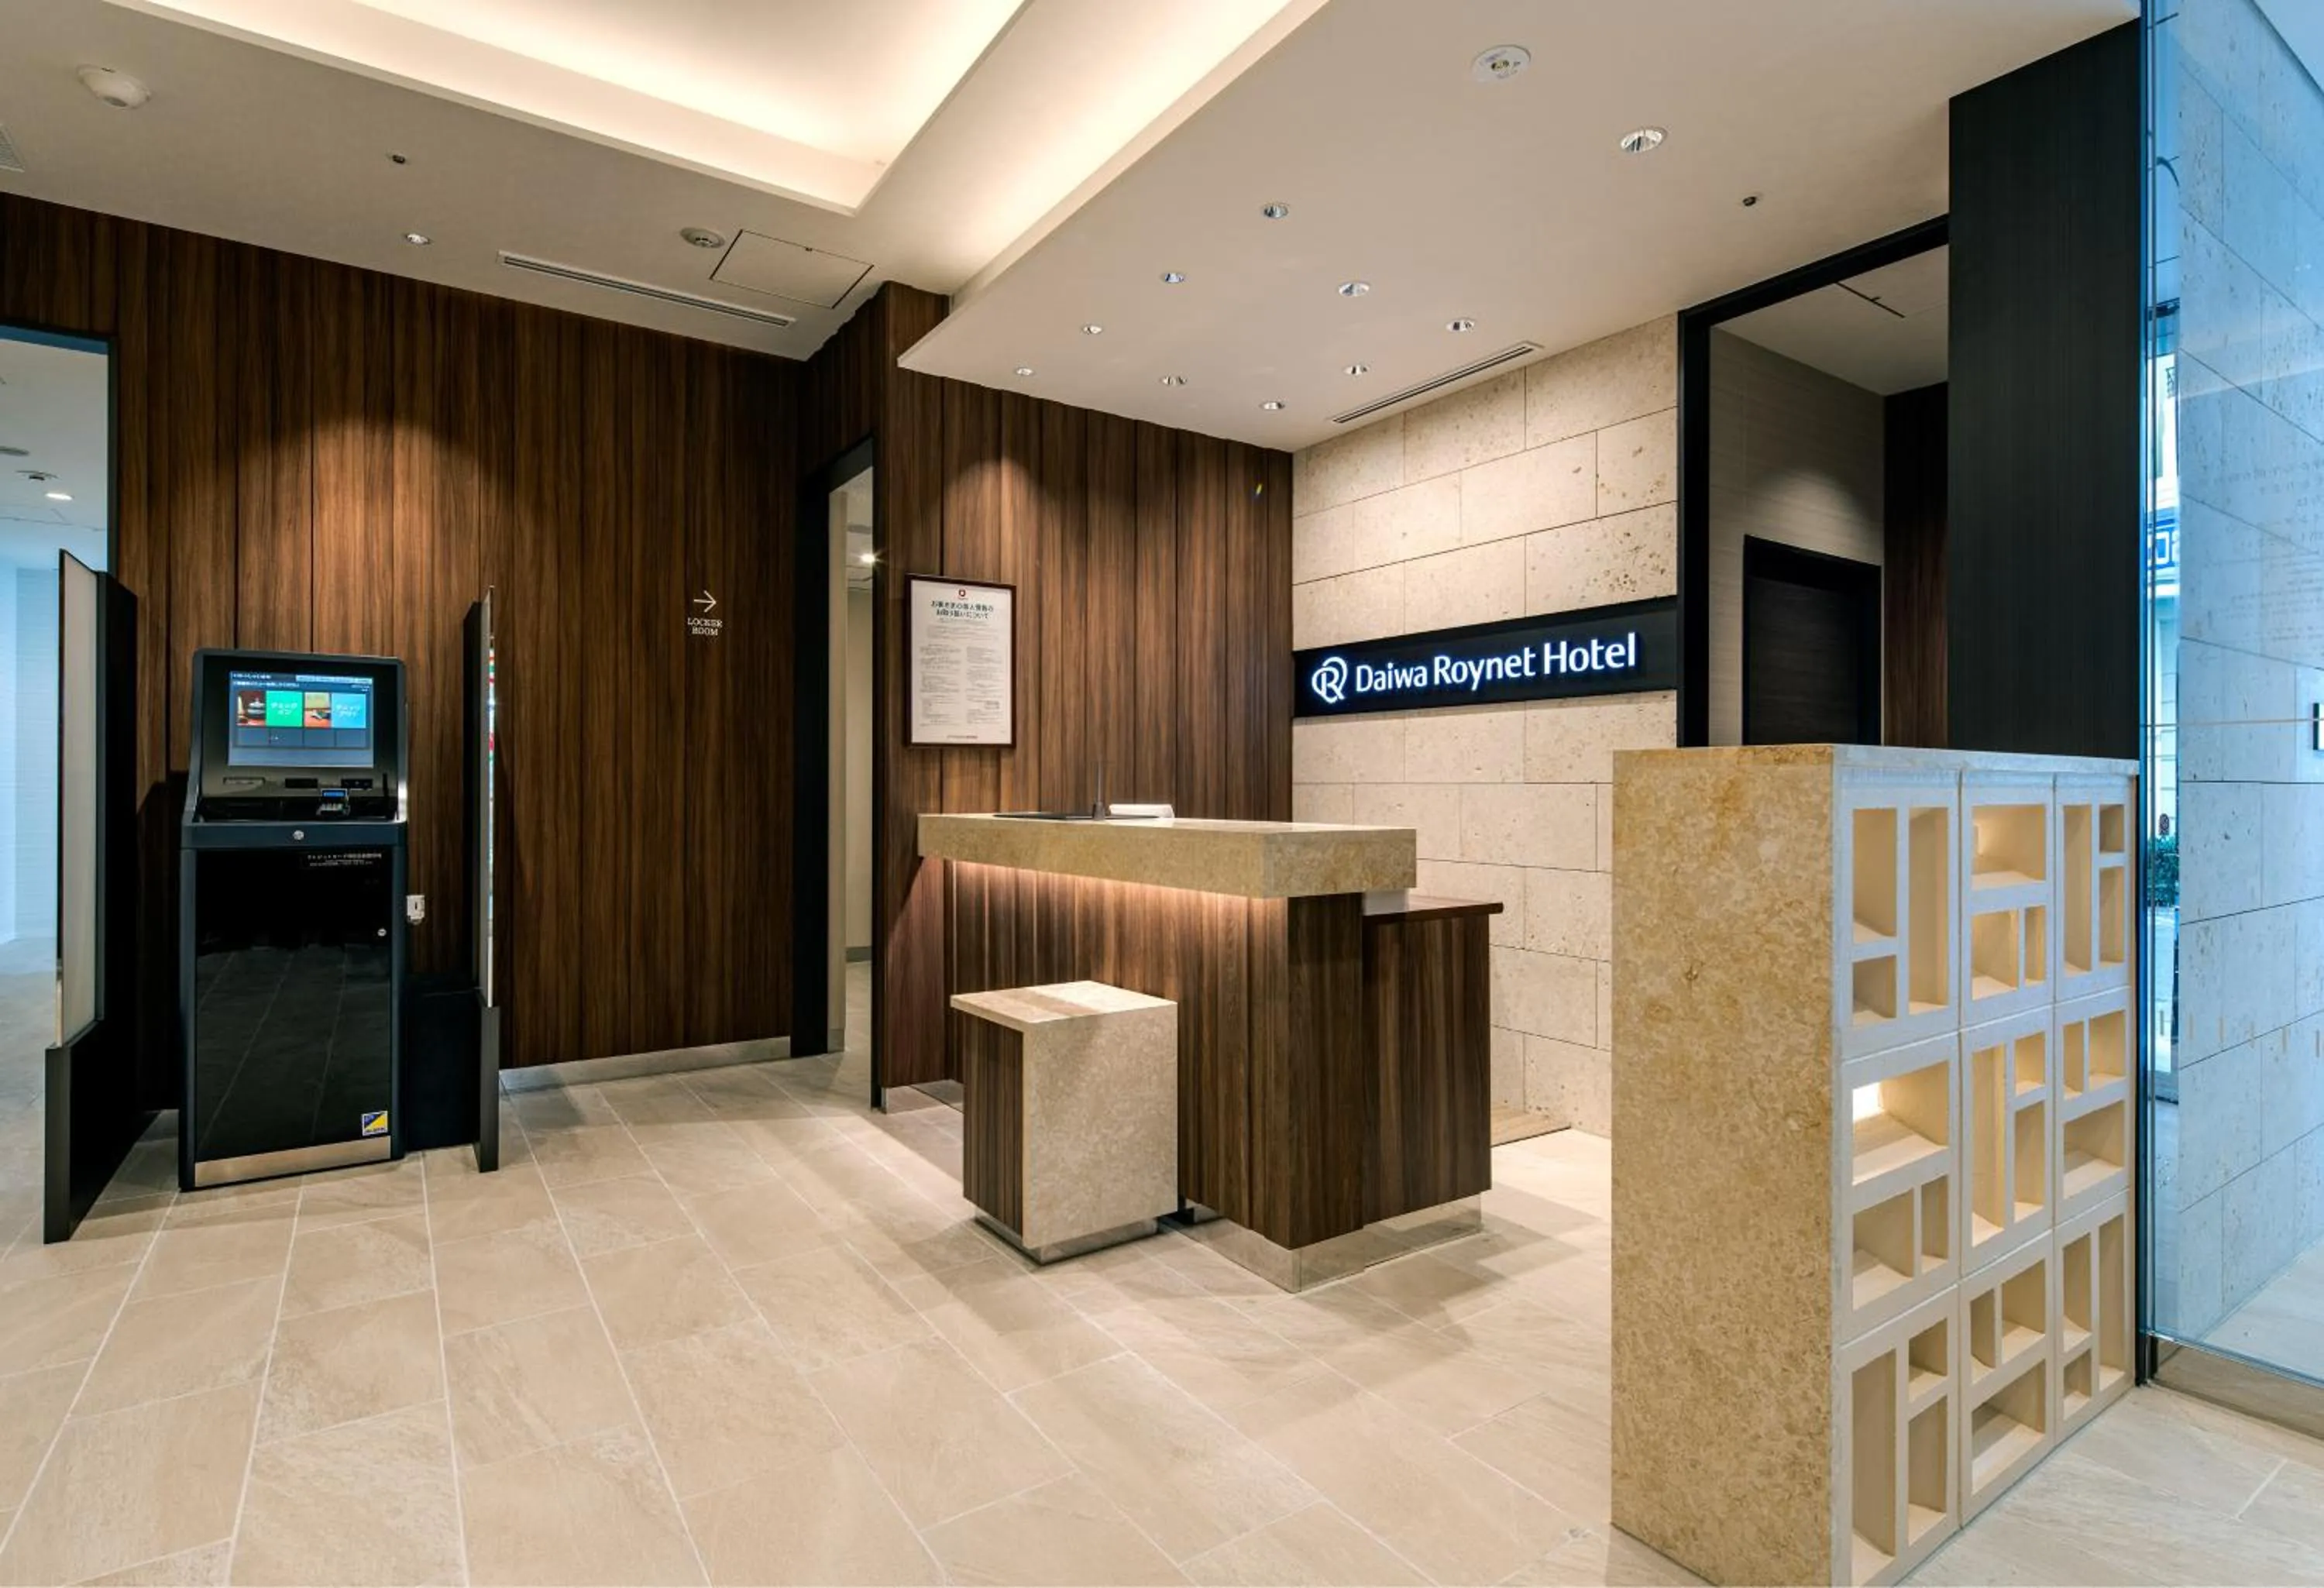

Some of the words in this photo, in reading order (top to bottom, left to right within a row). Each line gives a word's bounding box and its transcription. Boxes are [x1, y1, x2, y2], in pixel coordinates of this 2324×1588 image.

[687, 617, 723, 627] LOCKER
[692, 627, 718, 635] ROOM
[1356, 662, 1427, 692] Daiwa
[1433, 646, 1536, 691] Roynet
[1544, 631, 1635, 675] Hotel
